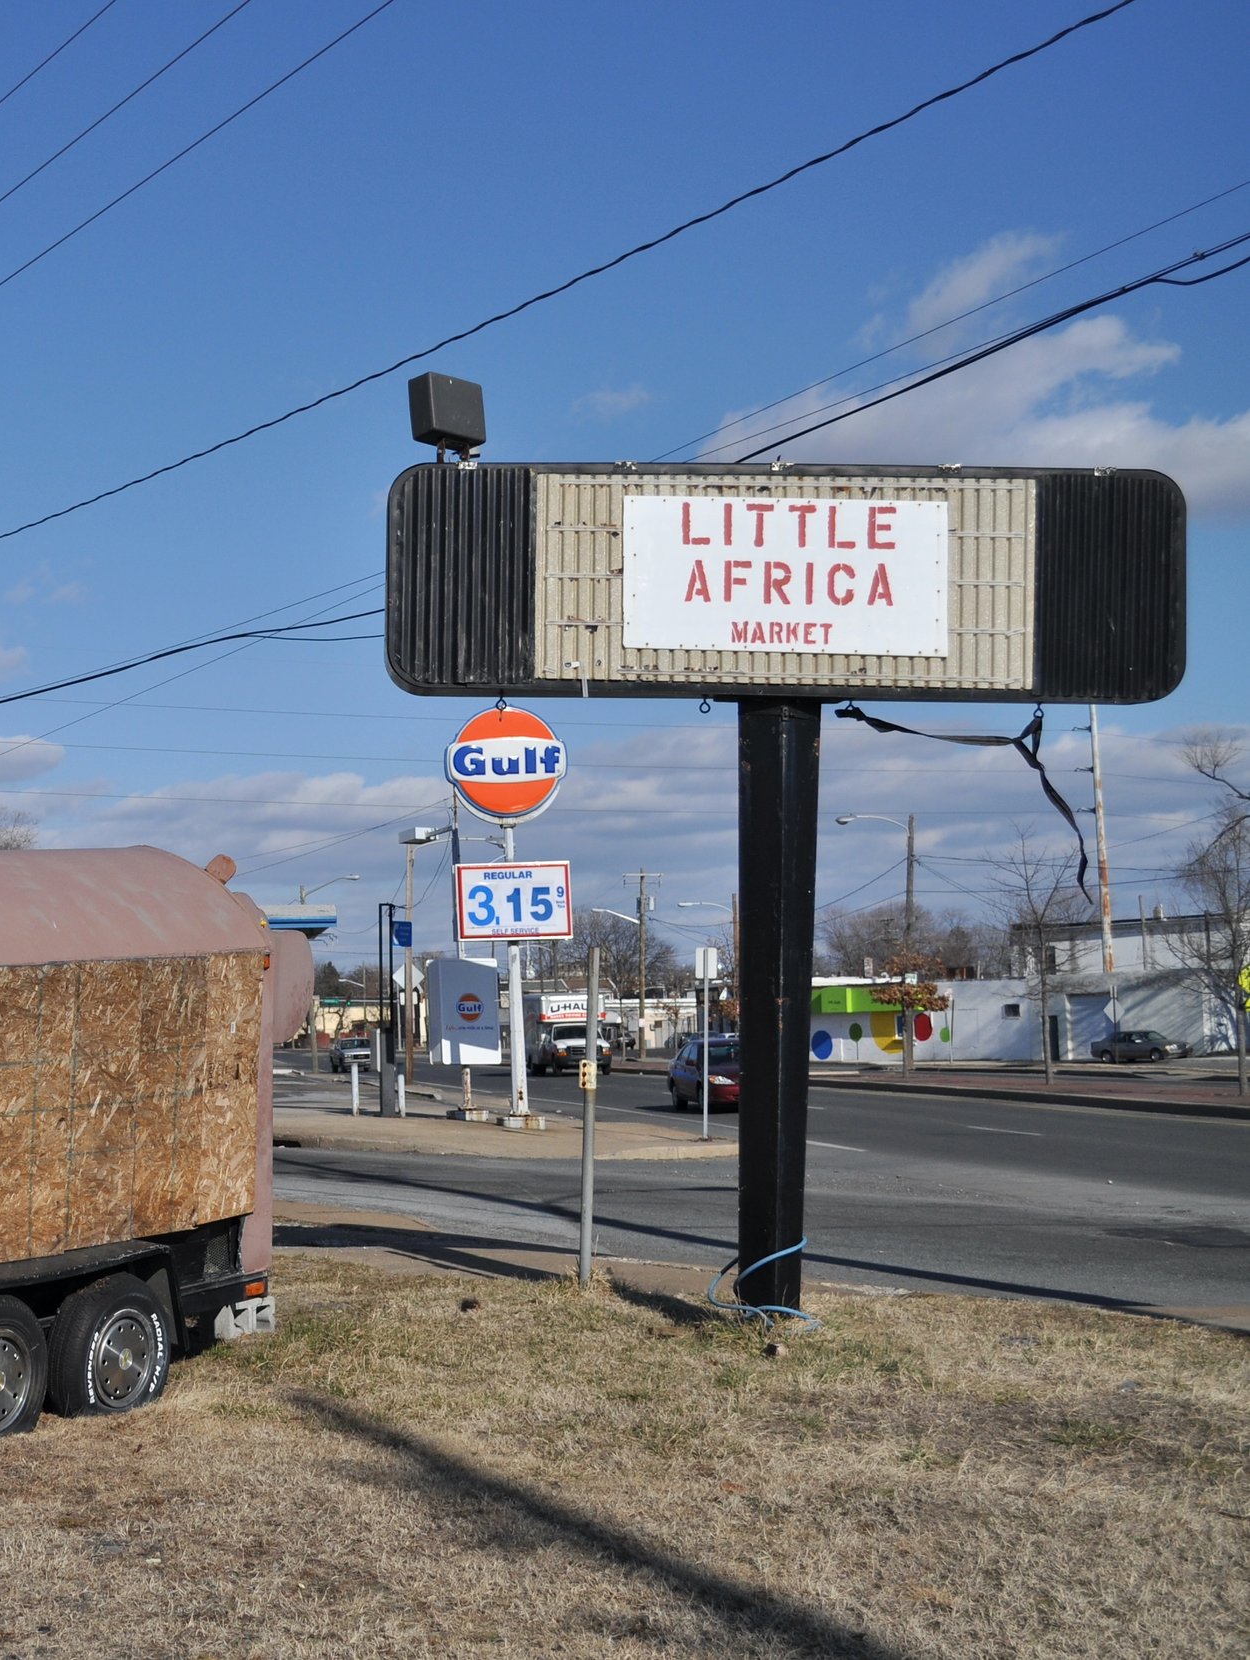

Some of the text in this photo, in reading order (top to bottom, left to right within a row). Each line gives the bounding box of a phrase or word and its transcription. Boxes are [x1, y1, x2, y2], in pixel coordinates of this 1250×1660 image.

[681, 502, 897, 549] LITTLE
[684, 559, 894, 606] AFRICA
[731, 620, 833, 645] MARKET
[453, 745, 561, 776] Gulf
[483, 870, 533, 880] REGULAR
[491, 927, 540, 936] SELF SERVICE
[458, 1003, 482, 1012] Gulf
[550, 1002, 588, 1013] U-HAU
[151, 1313, 164, 1359] RADIAL
